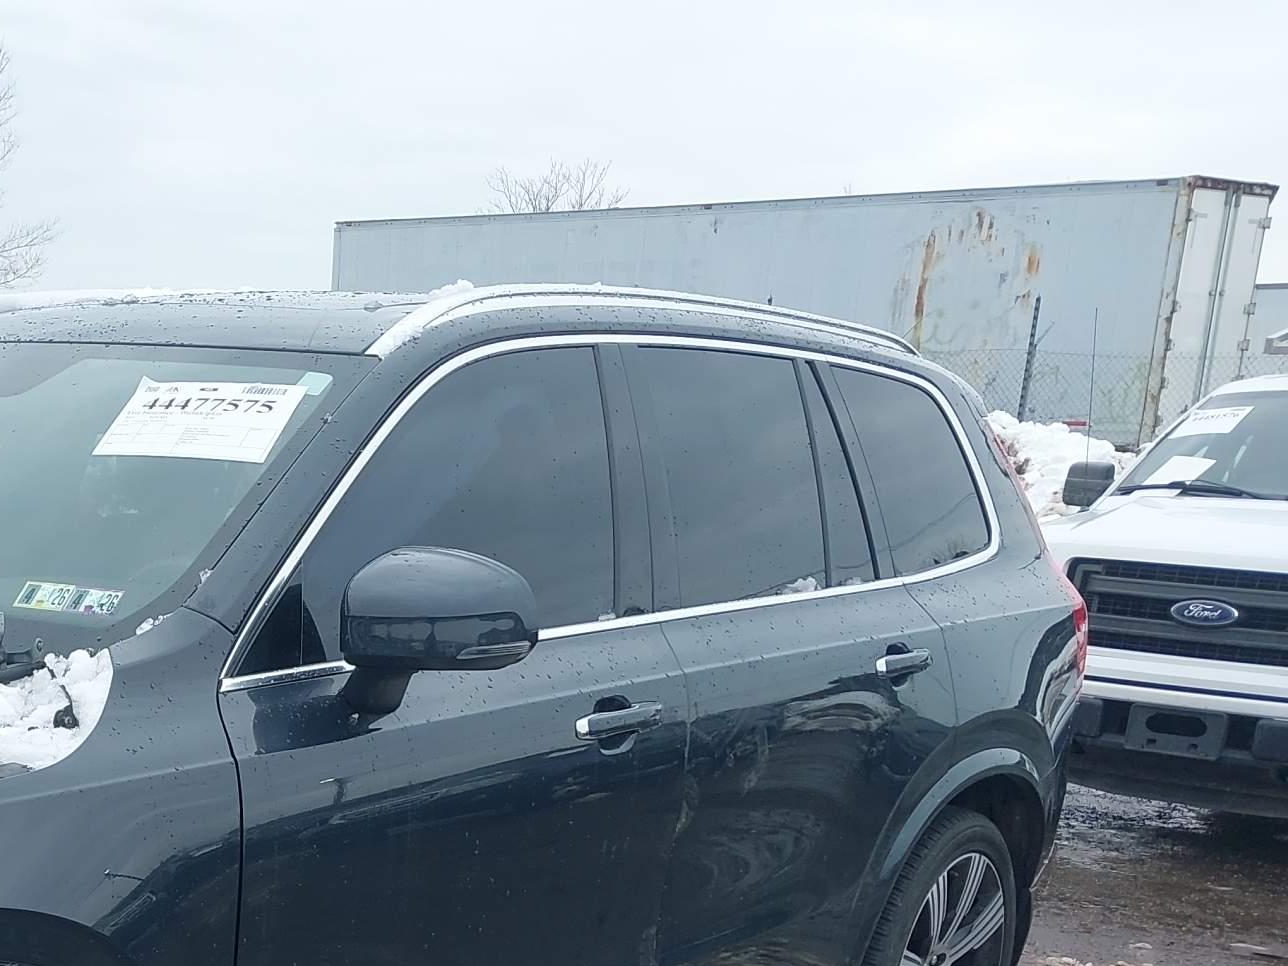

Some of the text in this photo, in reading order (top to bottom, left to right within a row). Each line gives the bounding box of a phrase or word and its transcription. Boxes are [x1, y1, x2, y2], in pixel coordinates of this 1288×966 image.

[142, 397, 277, 414] 44477575
[51, 588, 71, 606] 26
[100, 594, 120, 613] 26
[1183, 603, 1222, 619] Ford
